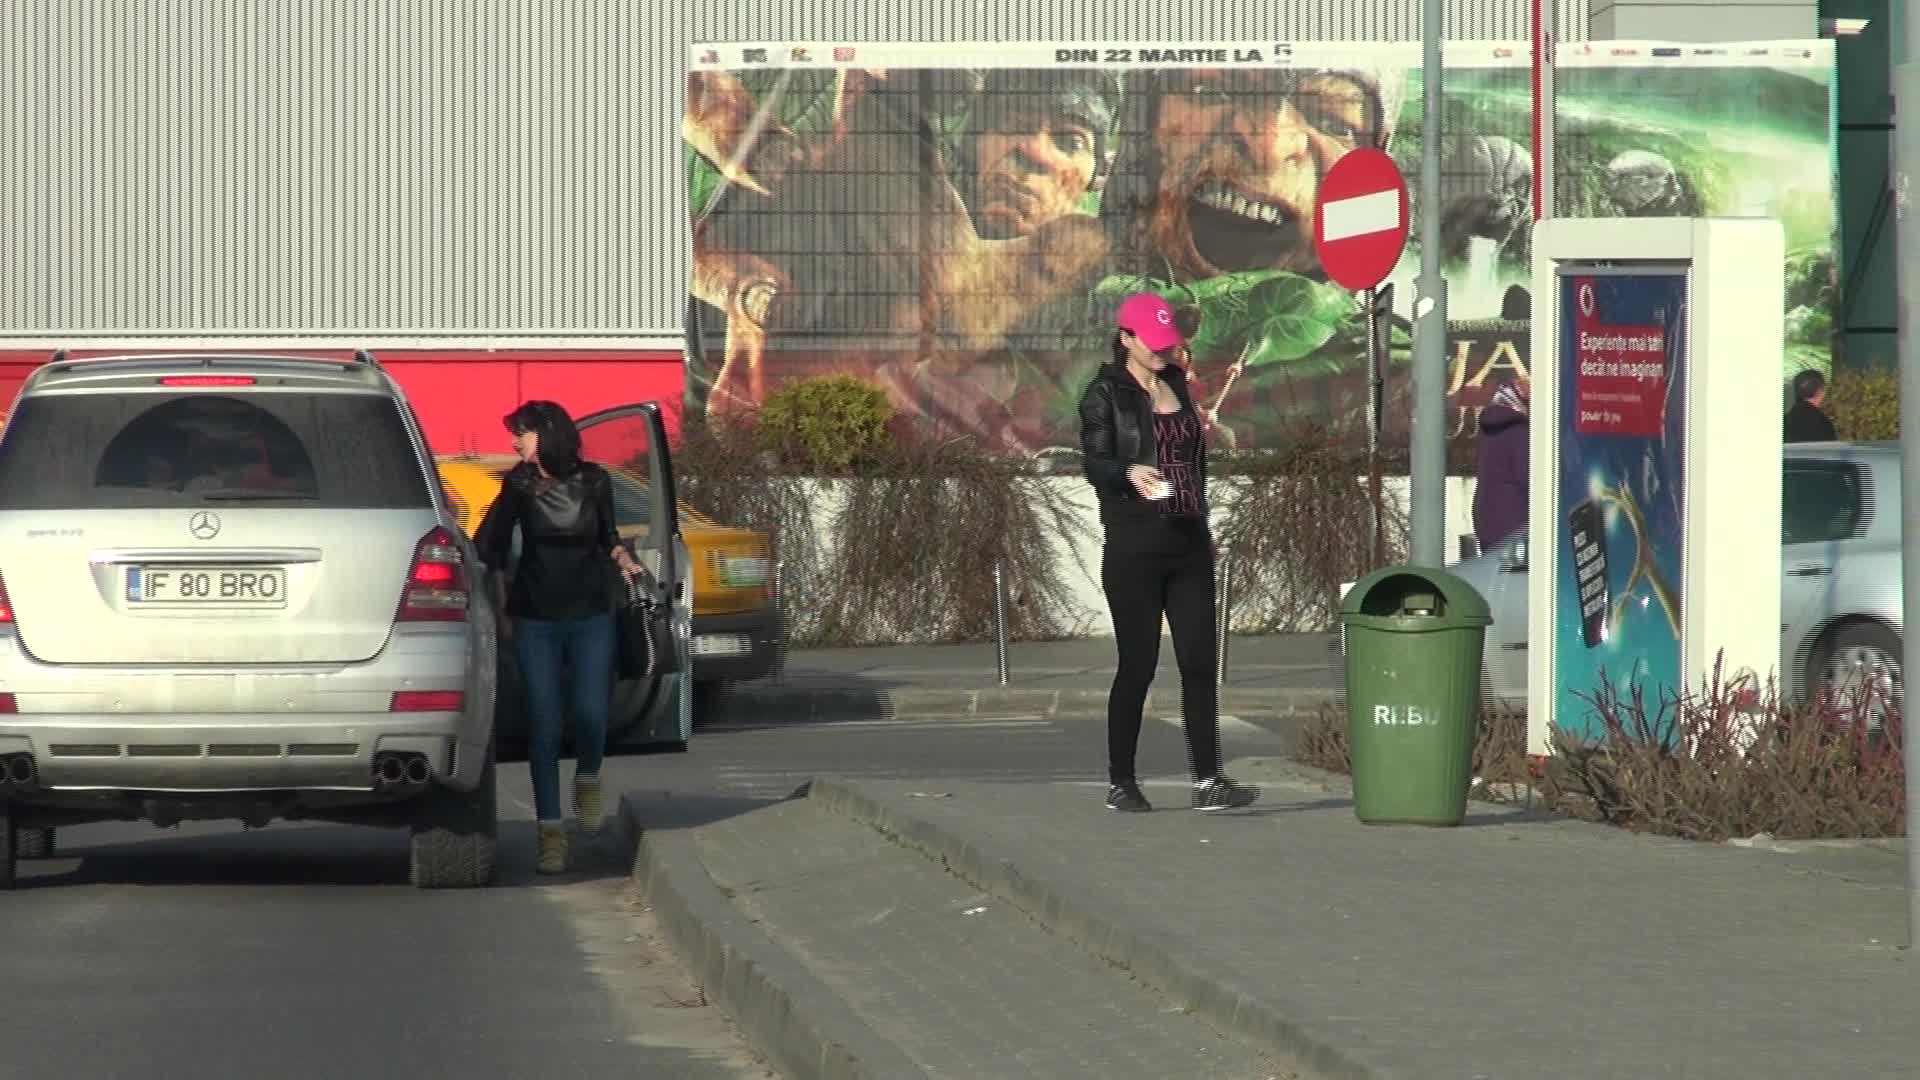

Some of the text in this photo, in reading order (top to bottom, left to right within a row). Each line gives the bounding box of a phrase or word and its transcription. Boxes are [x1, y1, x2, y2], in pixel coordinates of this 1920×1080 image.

[1055, 49, 1098, 63] DIN
[1103, 49, 1133, 63] 22
[1138, 49, 1227, 63] MARTIE
[1233, 49, 1264, 63] LA
[144, 573, 170, 598] IF
[179, 573, 210, 598] 80
[219, 573, 278, 598] BRO
